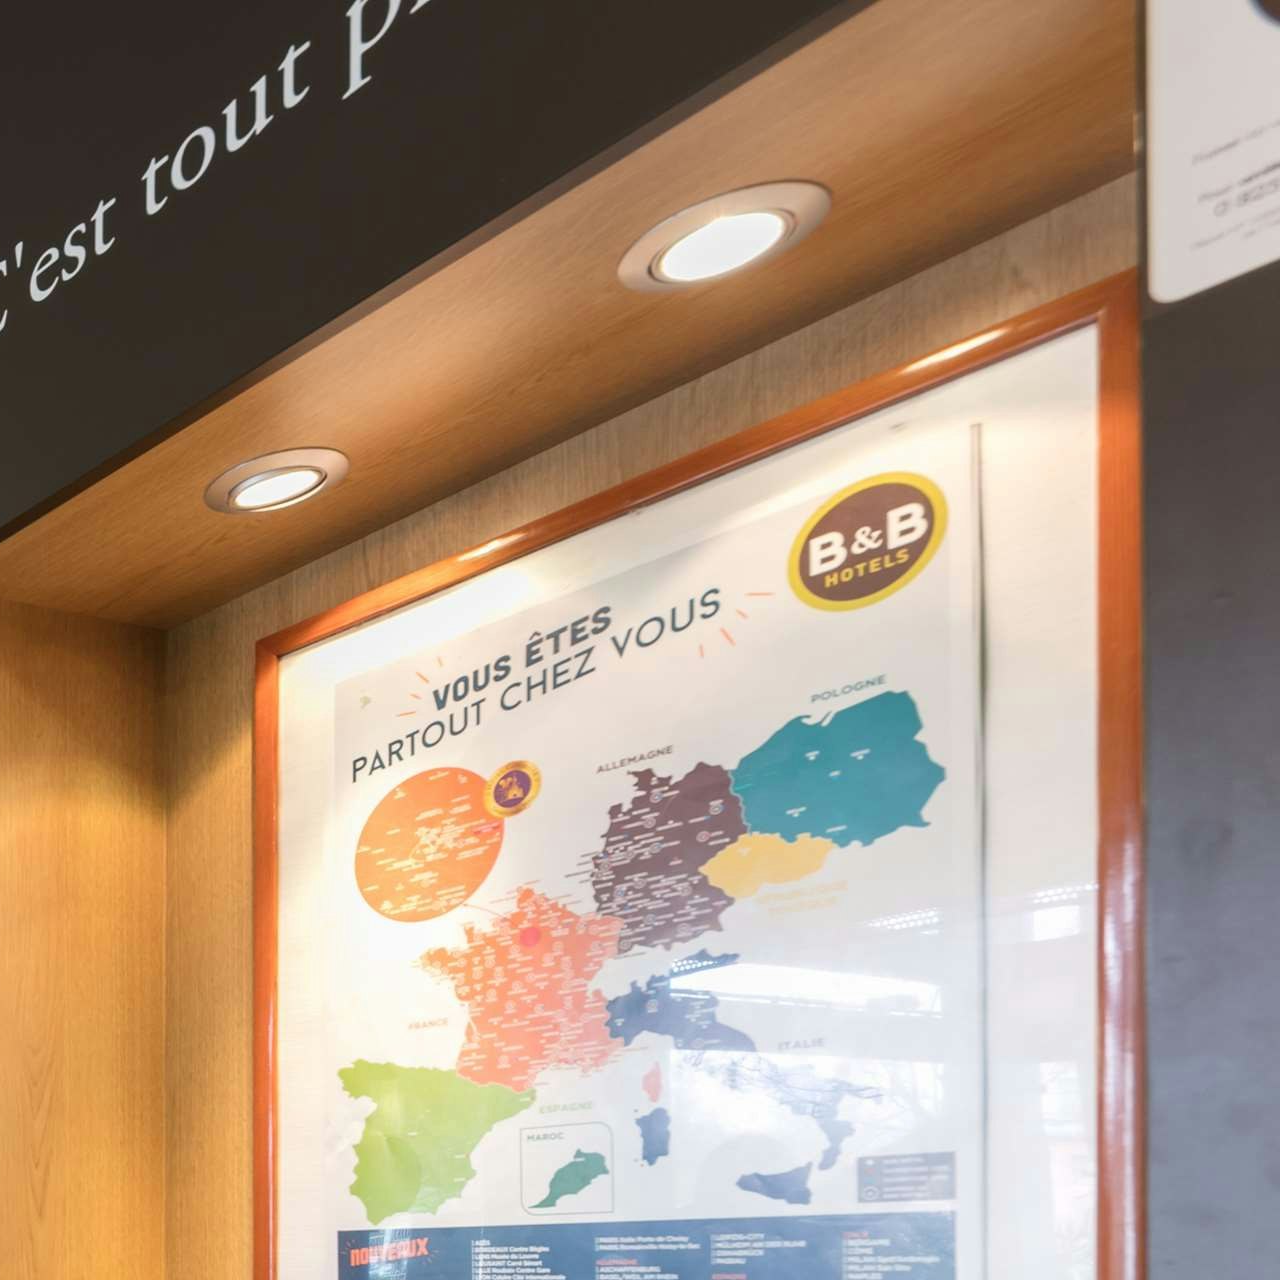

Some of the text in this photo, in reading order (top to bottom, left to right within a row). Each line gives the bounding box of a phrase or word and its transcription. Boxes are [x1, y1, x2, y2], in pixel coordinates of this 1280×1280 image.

[141, 40, 310, 215] tout
[809, 502, 928, 576] B&B
[824, 549, 910, 588] HOTELS
[433, 605, 611, 711] VOUS ÊTES
[352, 588, 721, 783] PARTOUT CHEZ VOUS
[811, 673, 887, 703] POLOGNE
[596, 745, 675, 772] ALLEMAGNE
[407, 1017, 448, 1031] FRANCE
[778, 1038, 824, 1050] ITALIE
[540, 1101, 592, 1114] ESPAGNE
[527, 1132, 564, 1142] MAROC
[350, 1237, 430, 1267] NOUVEAUX
